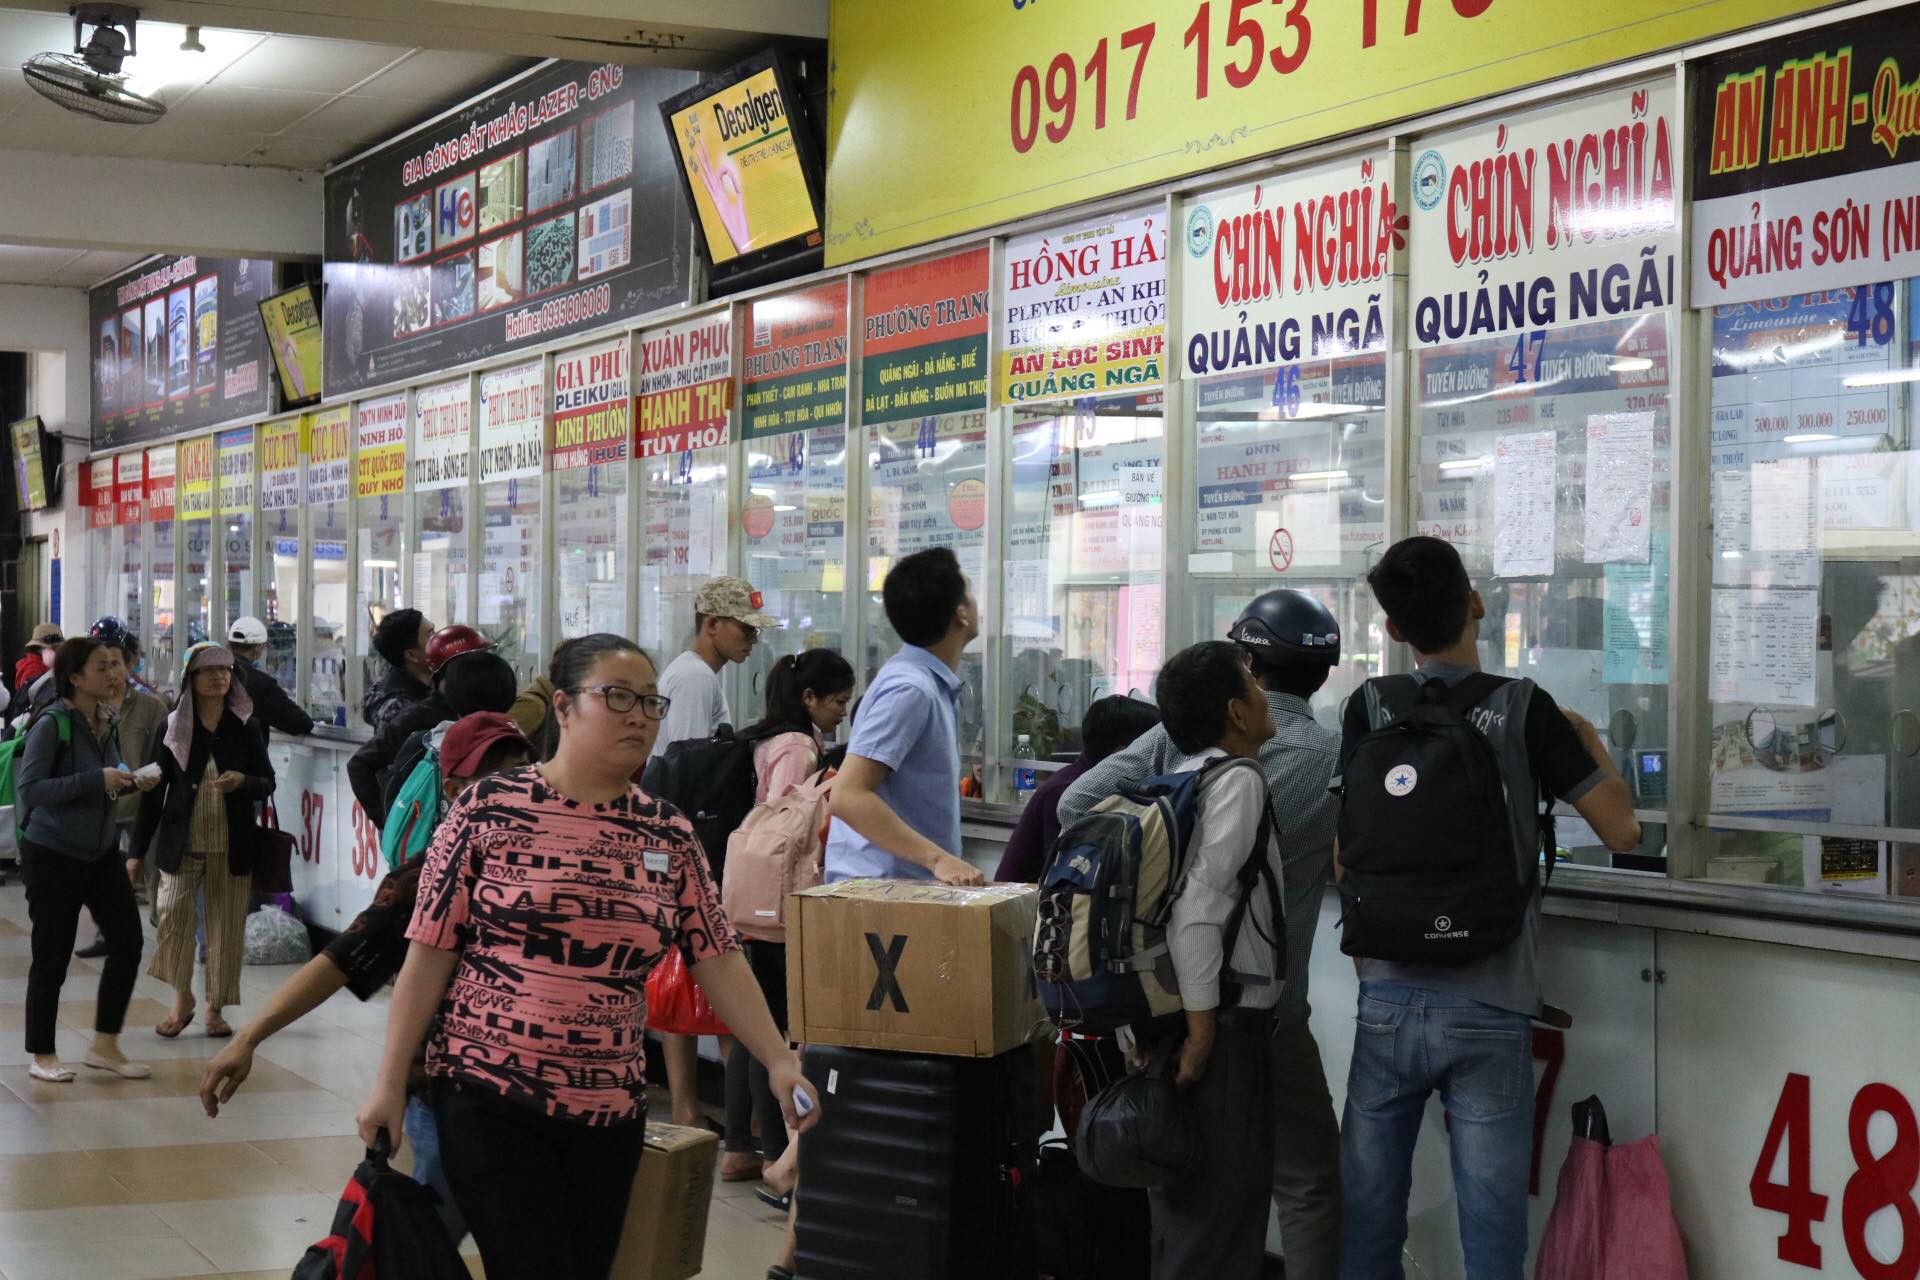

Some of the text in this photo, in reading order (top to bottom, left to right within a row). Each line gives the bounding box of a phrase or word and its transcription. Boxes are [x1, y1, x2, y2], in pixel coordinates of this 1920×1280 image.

[1010, 21, 1156, 154] 0917
[1183, 0, 1312, 100] 153
[403, 63, 624, 186] GIA CÔNG CẮT KHẮC LAZER CNC
[714, 87, 784, 142] Decolgen
[1709, 65, 1767, 176] AN
[1768, 45, 1853, 164] ANH
[1446, 88, 1675, 269] CHÍN NGHĨA
[1213, 183, 1285, 308] CHÍN
[1293, 157, 1389, 296] NGHĨA
[1708, 200, 1803, 290] QUẢNG
[1811, 197, 1871, 267] SƠN
[1008, 239, 1101, 291] HỒNG
[505, 282, 611, 341] Hotline: 0935 80 80 80
[865, 303, 931, 341] PHƯƠNG
[1007, 295, 1081, 324] PLEYKU
[1096, 287, 1126, 308] AN
[1415, 269, 1556, 345] QUẢNG
[1729, 312, 1818, 332] Limousine
[1848, 281, 1896, 348] 48
[641, 329, 684, 375] XUÂN
[744, 344, 800, 379] PHƯƠNG
[1187, 310, 1301, 376] QUẢNG
[1508, 329, 1547, 384] 47
[555, 359, 584, 392] GIA
[640, 375, 651, 394] AN
[652, 369, 672, 393] NHƠN
[880, 346, 977, 386] QUẢNG NGÃI ĐÀ NẴNG HUẾ
[1007, 358, 1161, 401] QUẢNG NGÃ
[1008, 353, 1045, 377] AN
[1426, 362, 1489, 394] TUYẾN ĐƯỜNG
[1539, 349, 1611, 382] TUYẾN ĐƯỜNG
[555, 383, 610, 411] PLEIKU
[746, 392, 761, 408] PHAN
[762, 384, 778, 404] THIẾT
[783, 384, 796, 401] CAM
[796, 382, 813, 397] RANH
[817, 378, 830, 393] NHA
[865, 393, 875, 412] ĐÀ
[876, 394, 889, 413] LẠT
[910, 386, 929, 405] NÔNG
[934, 380, 955, 401] BUÔN
[955, 382, 967, 398] MA
[1271, 364, 1301, 420] 46
[1353, 376, 1383, 402] ĐƯỜNG
[359, 404, 393, 428] DNTN MINH
[640, 387, 691, 439] HẠNH
[784, 409, 796, 423] TUY
[825, 400, 843, 416] NHƠN
[1846, 407, 1887, 426] 250.000
[359, 429, 385, 447] NINH
[556, 414, 584, 449] MINH
[640, 433, 681, 457] TUY
[918, 416, 937, 459] 44
[1245, 443, 1281, 457] DNTN
[415, 448, 460, 485] TUY HÒA SÔNG
[480, 434, 527, 480] QUY NHƠN ĐÀ
[679, 449, 693, 485] 42
[789, 432, 804, 472] 43
[359, 480, 379, 495] QUY
[1216, 462, 1267, 482] HẠNH
[508, 478, 518, 508] 40
[1240, 626, 1272, 646] Vespa
[301, 788, 324, 865] 37
[351, 799, 378, 881] 38
[1424, 930, 1470, 940] CONVERSE
[863, 932, 911, 1014] X
[1510, 1027, 1566, 1197] 7
[1748, 1071, 1920, 1280] 48
